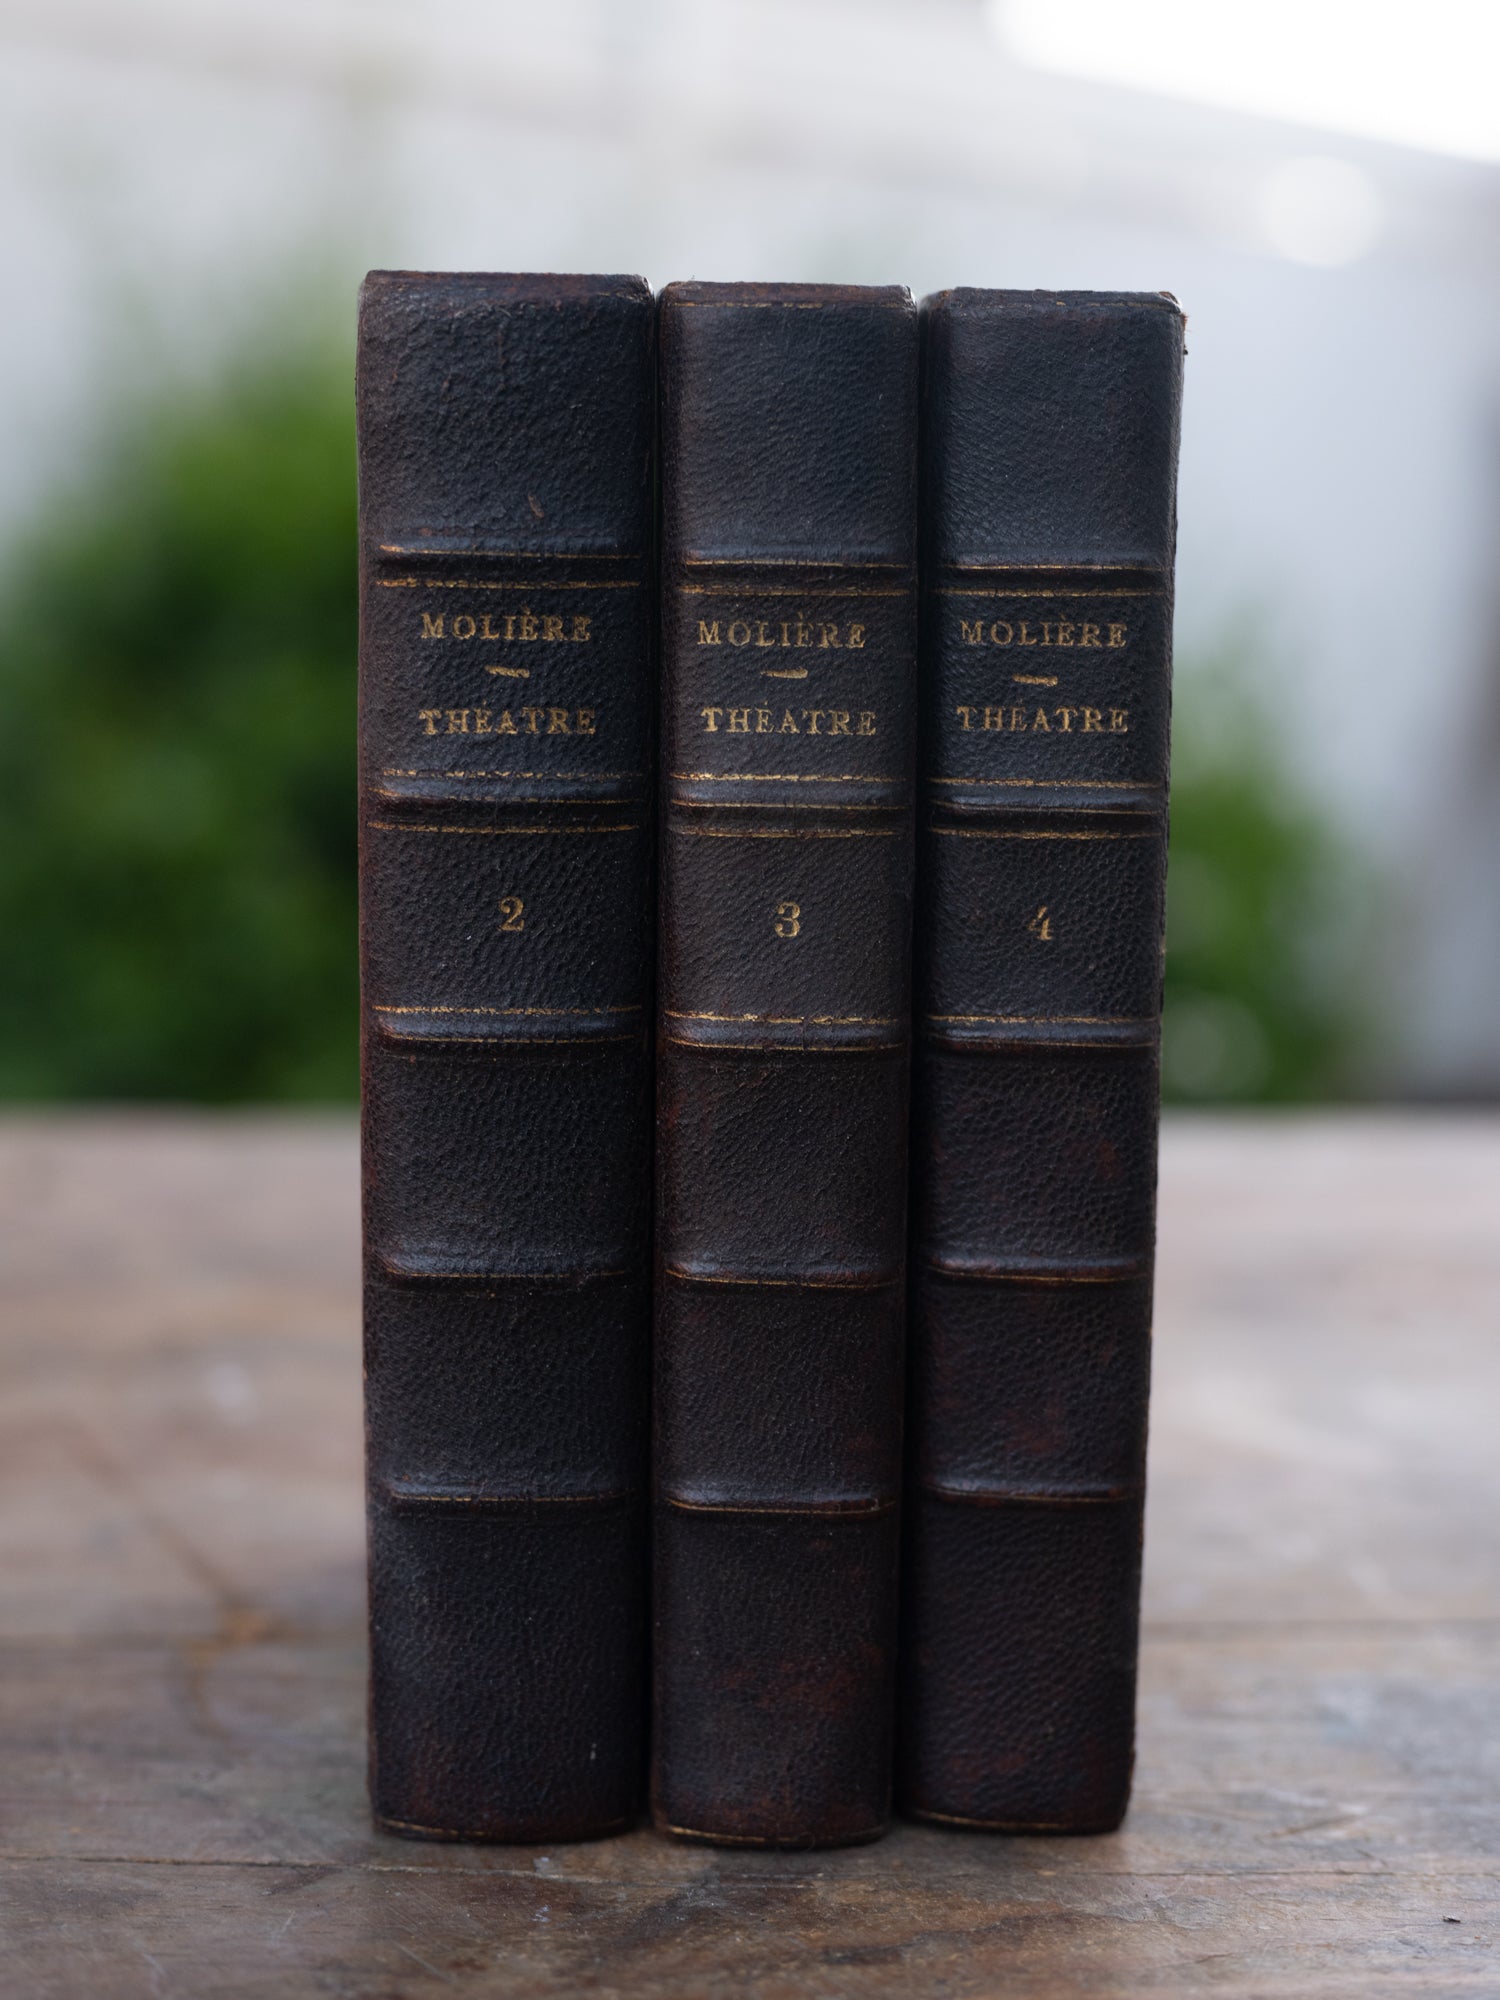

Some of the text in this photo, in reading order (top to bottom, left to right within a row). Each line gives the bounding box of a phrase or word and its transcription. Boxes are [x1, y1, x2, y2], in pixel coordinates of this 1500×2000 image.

[420, 607, 594, 642] MOLIÈRE
[697, 612, 867, 649] MOLIÈRE
[960, 614, 1128, 648] MOLIÈRE
[498, 896, 525, 932] 2
[774, 901, 801, 938] 3
[1028, 906, 1053, 941] 4
